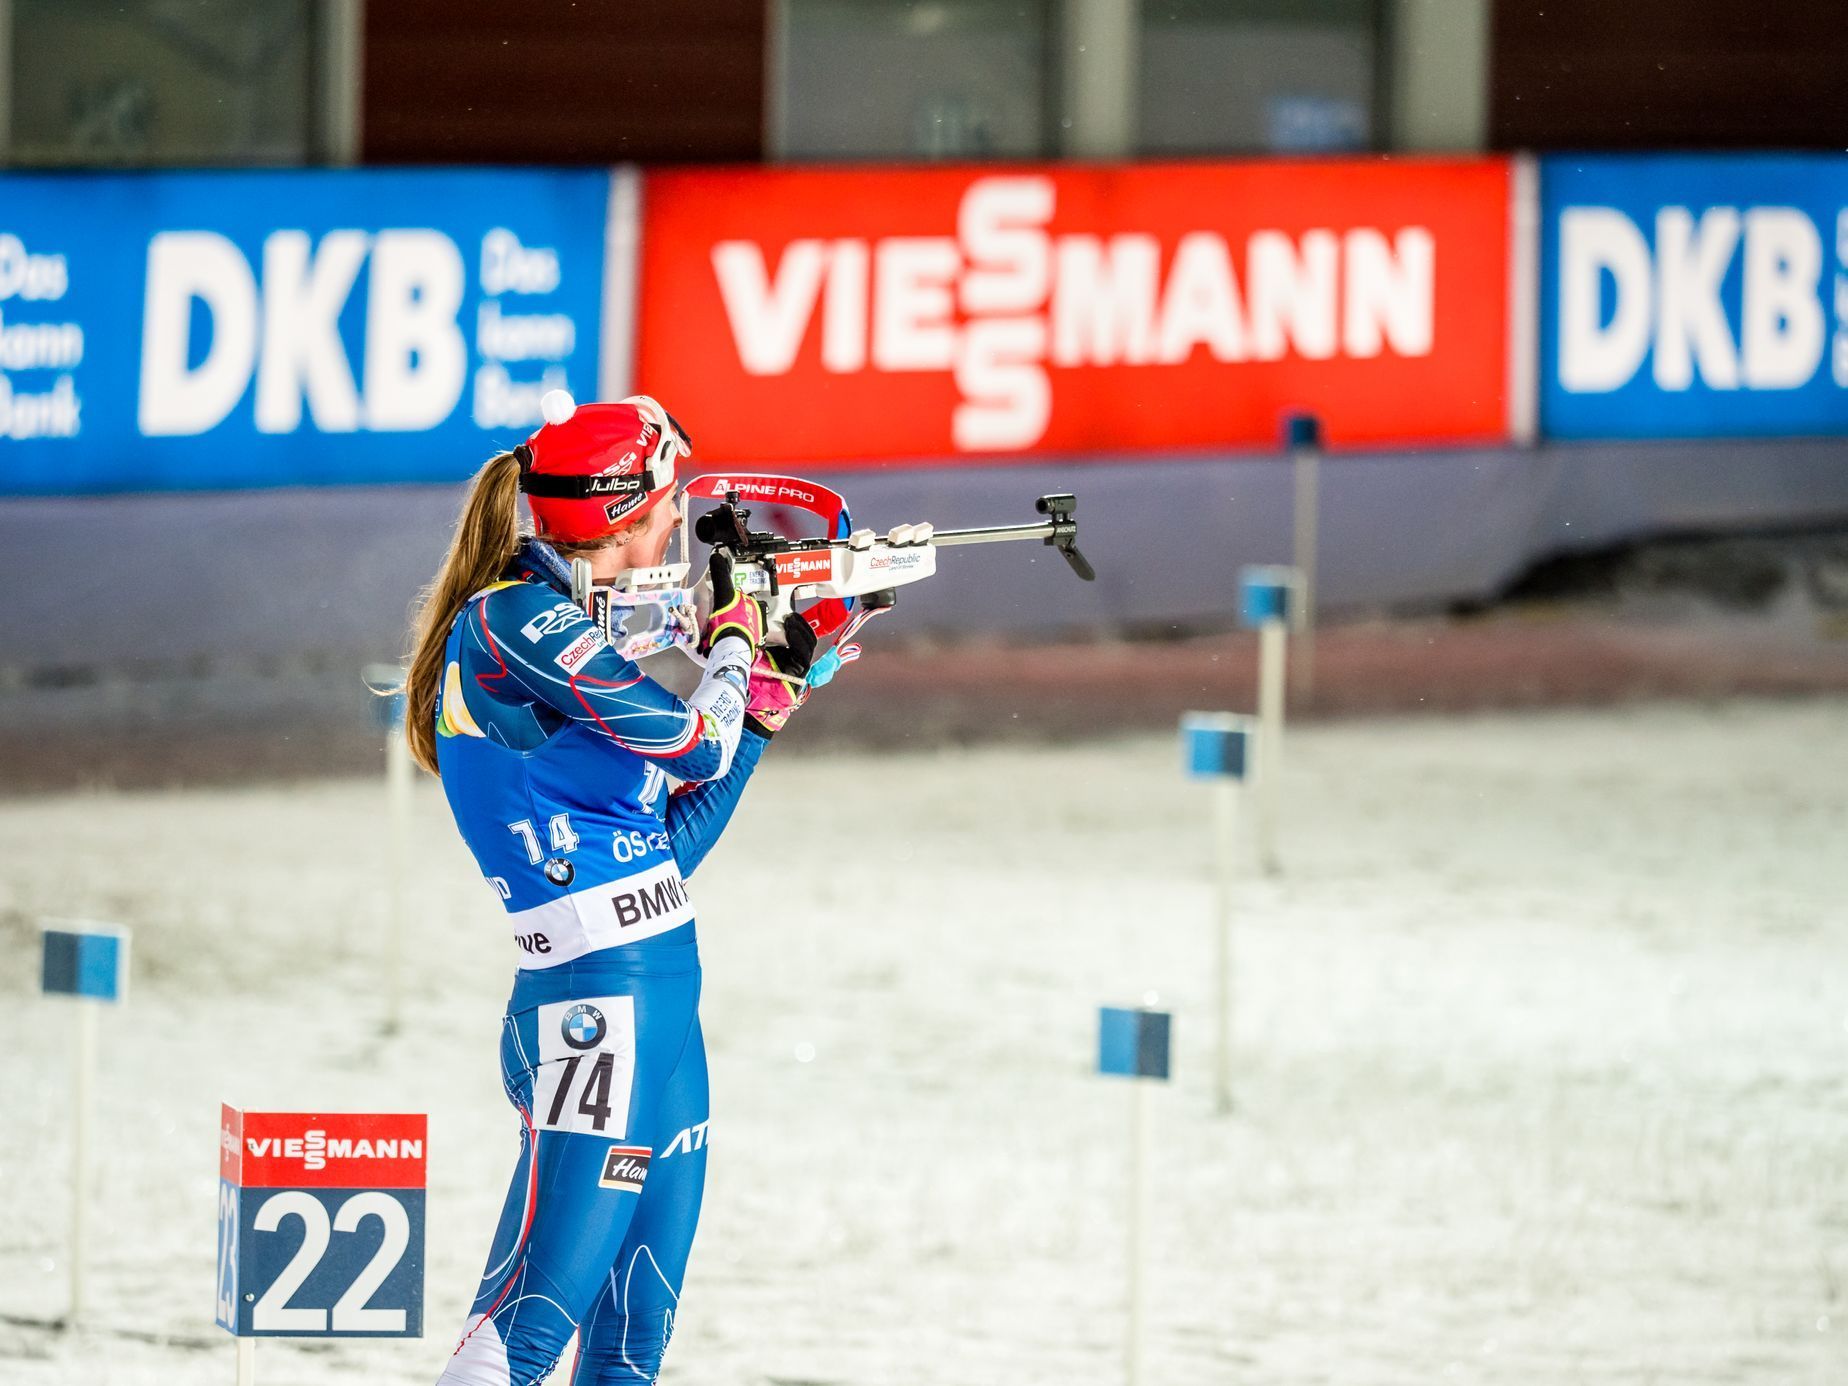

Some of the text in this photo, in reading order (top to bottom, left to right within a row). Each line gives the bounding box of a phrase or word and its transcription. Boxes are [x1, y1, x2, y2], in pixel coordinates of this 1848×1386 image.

[711, 175, 1435, 451] VIESSMANN
[1557, 205, 1827, 394] DKB
[0, 315, 84, 370] ann
[137, 227, 468, 437] DKB
[585, 478, 640, 493] Julbo
[711, 479, 815, 503] ALPINE PRO
[776, 558, 831, 578] VIESSMANN
[564, 1005, 603, 1021] BMW
[546, 1052, 615, 1131] 74
[246, 1130, 422, 1170] VIESSMANN
[252, 1190, 410, 1332] 22
